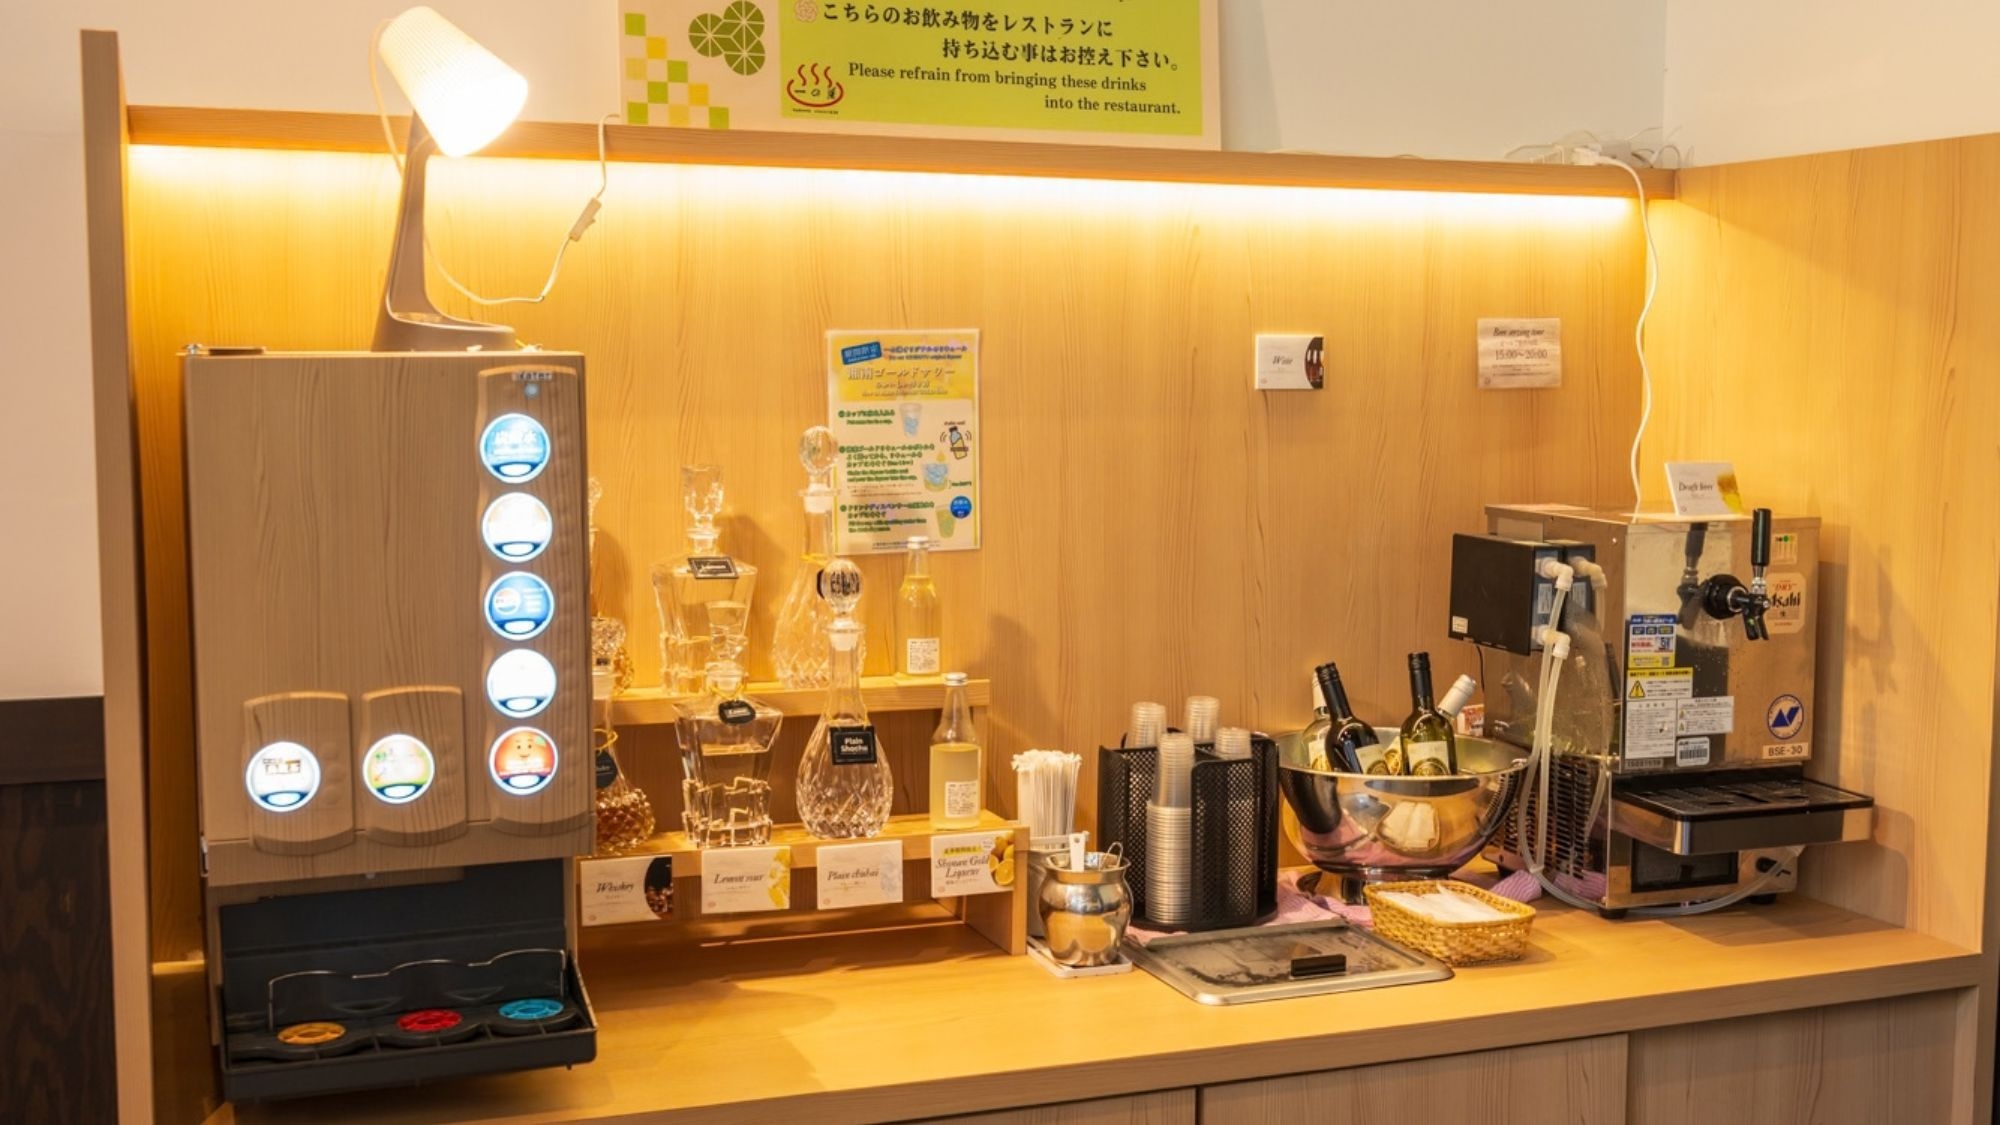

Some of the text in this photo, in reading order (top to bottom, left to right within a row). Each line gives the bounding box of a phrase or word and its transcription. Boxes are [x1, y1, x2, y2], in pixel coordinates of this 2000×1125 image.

[823, 3, 1114, 37] こちらのお飲み物をレストランに
[942, 38, 1178, 71] 持ち込む事はお控え下さい。
[849, 62, 1147, 91] Please refrain from bringing these drinks
[1044, 95, 1181, 114] into the restaurant.
[843, 737, 864, 745] Plain
[1768, 745, 1803, 757] BSE-30
[969, 855, 989, 866] Gold
[713, 873, 744, 884] Lemon
[826, 870, 851, 881] Plain
[945, 868, 980, 880] Liqueur
